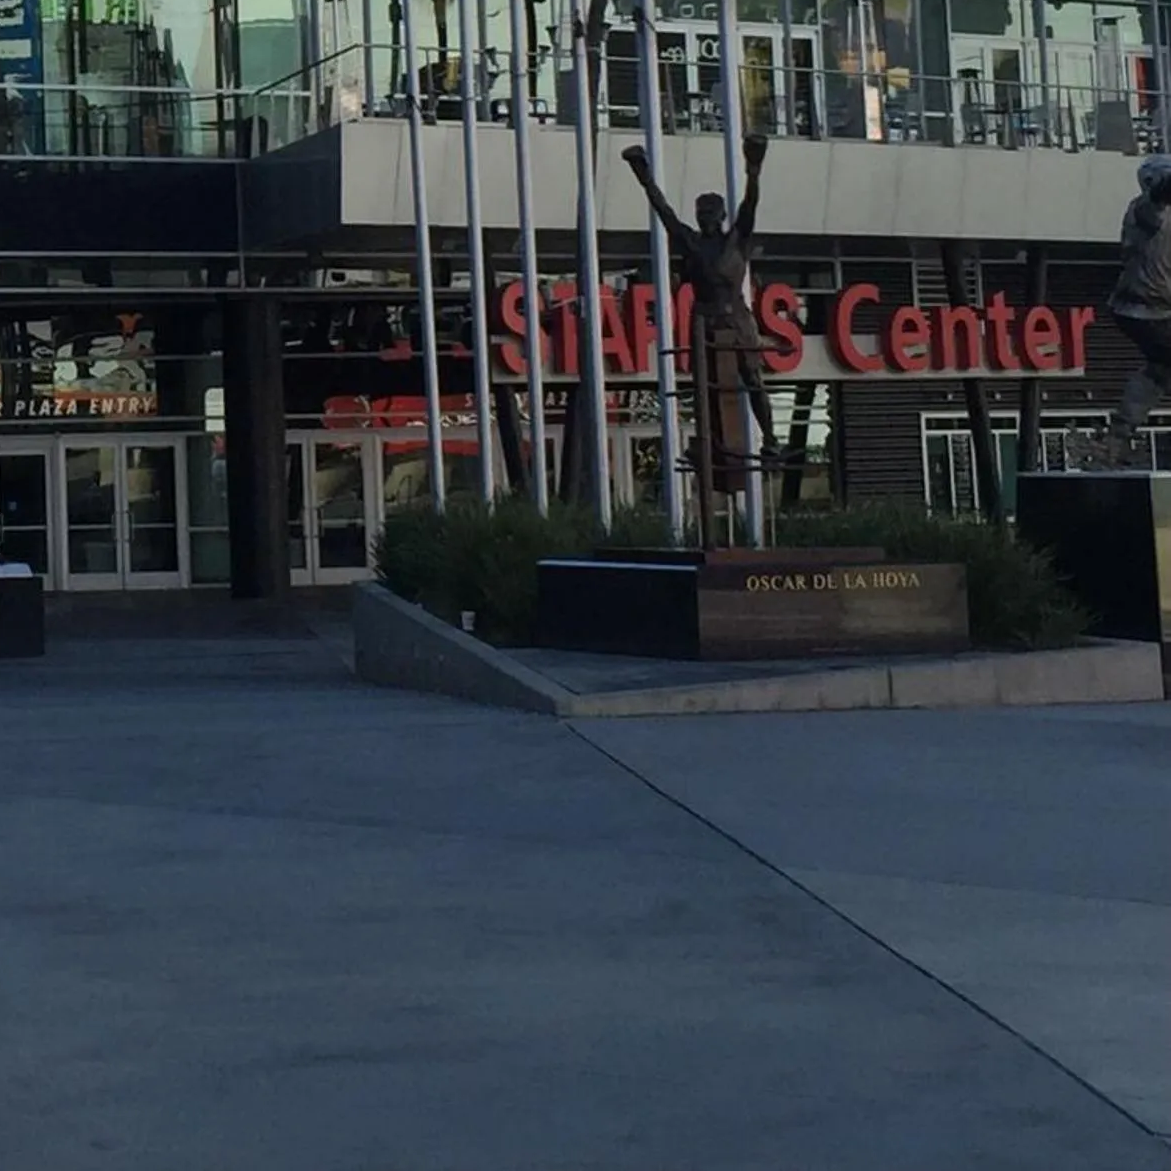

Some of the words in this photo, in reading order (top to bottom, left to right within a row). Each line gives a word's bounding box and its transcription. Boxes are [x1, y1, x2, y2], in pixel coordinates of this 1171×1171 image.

[499, 282, 804, 375] STAPS
[835, 282, 1096, 375] Center
[14, 399, 79, 417] PLAZA
[87, 395, 156, 415] ENTRY
[746, 574, 807, 591] OSCAR
[813, 573, 837, 590] DE
[844, 572, 867, 589] LA
[873, 571, 921, 588] HOYA
